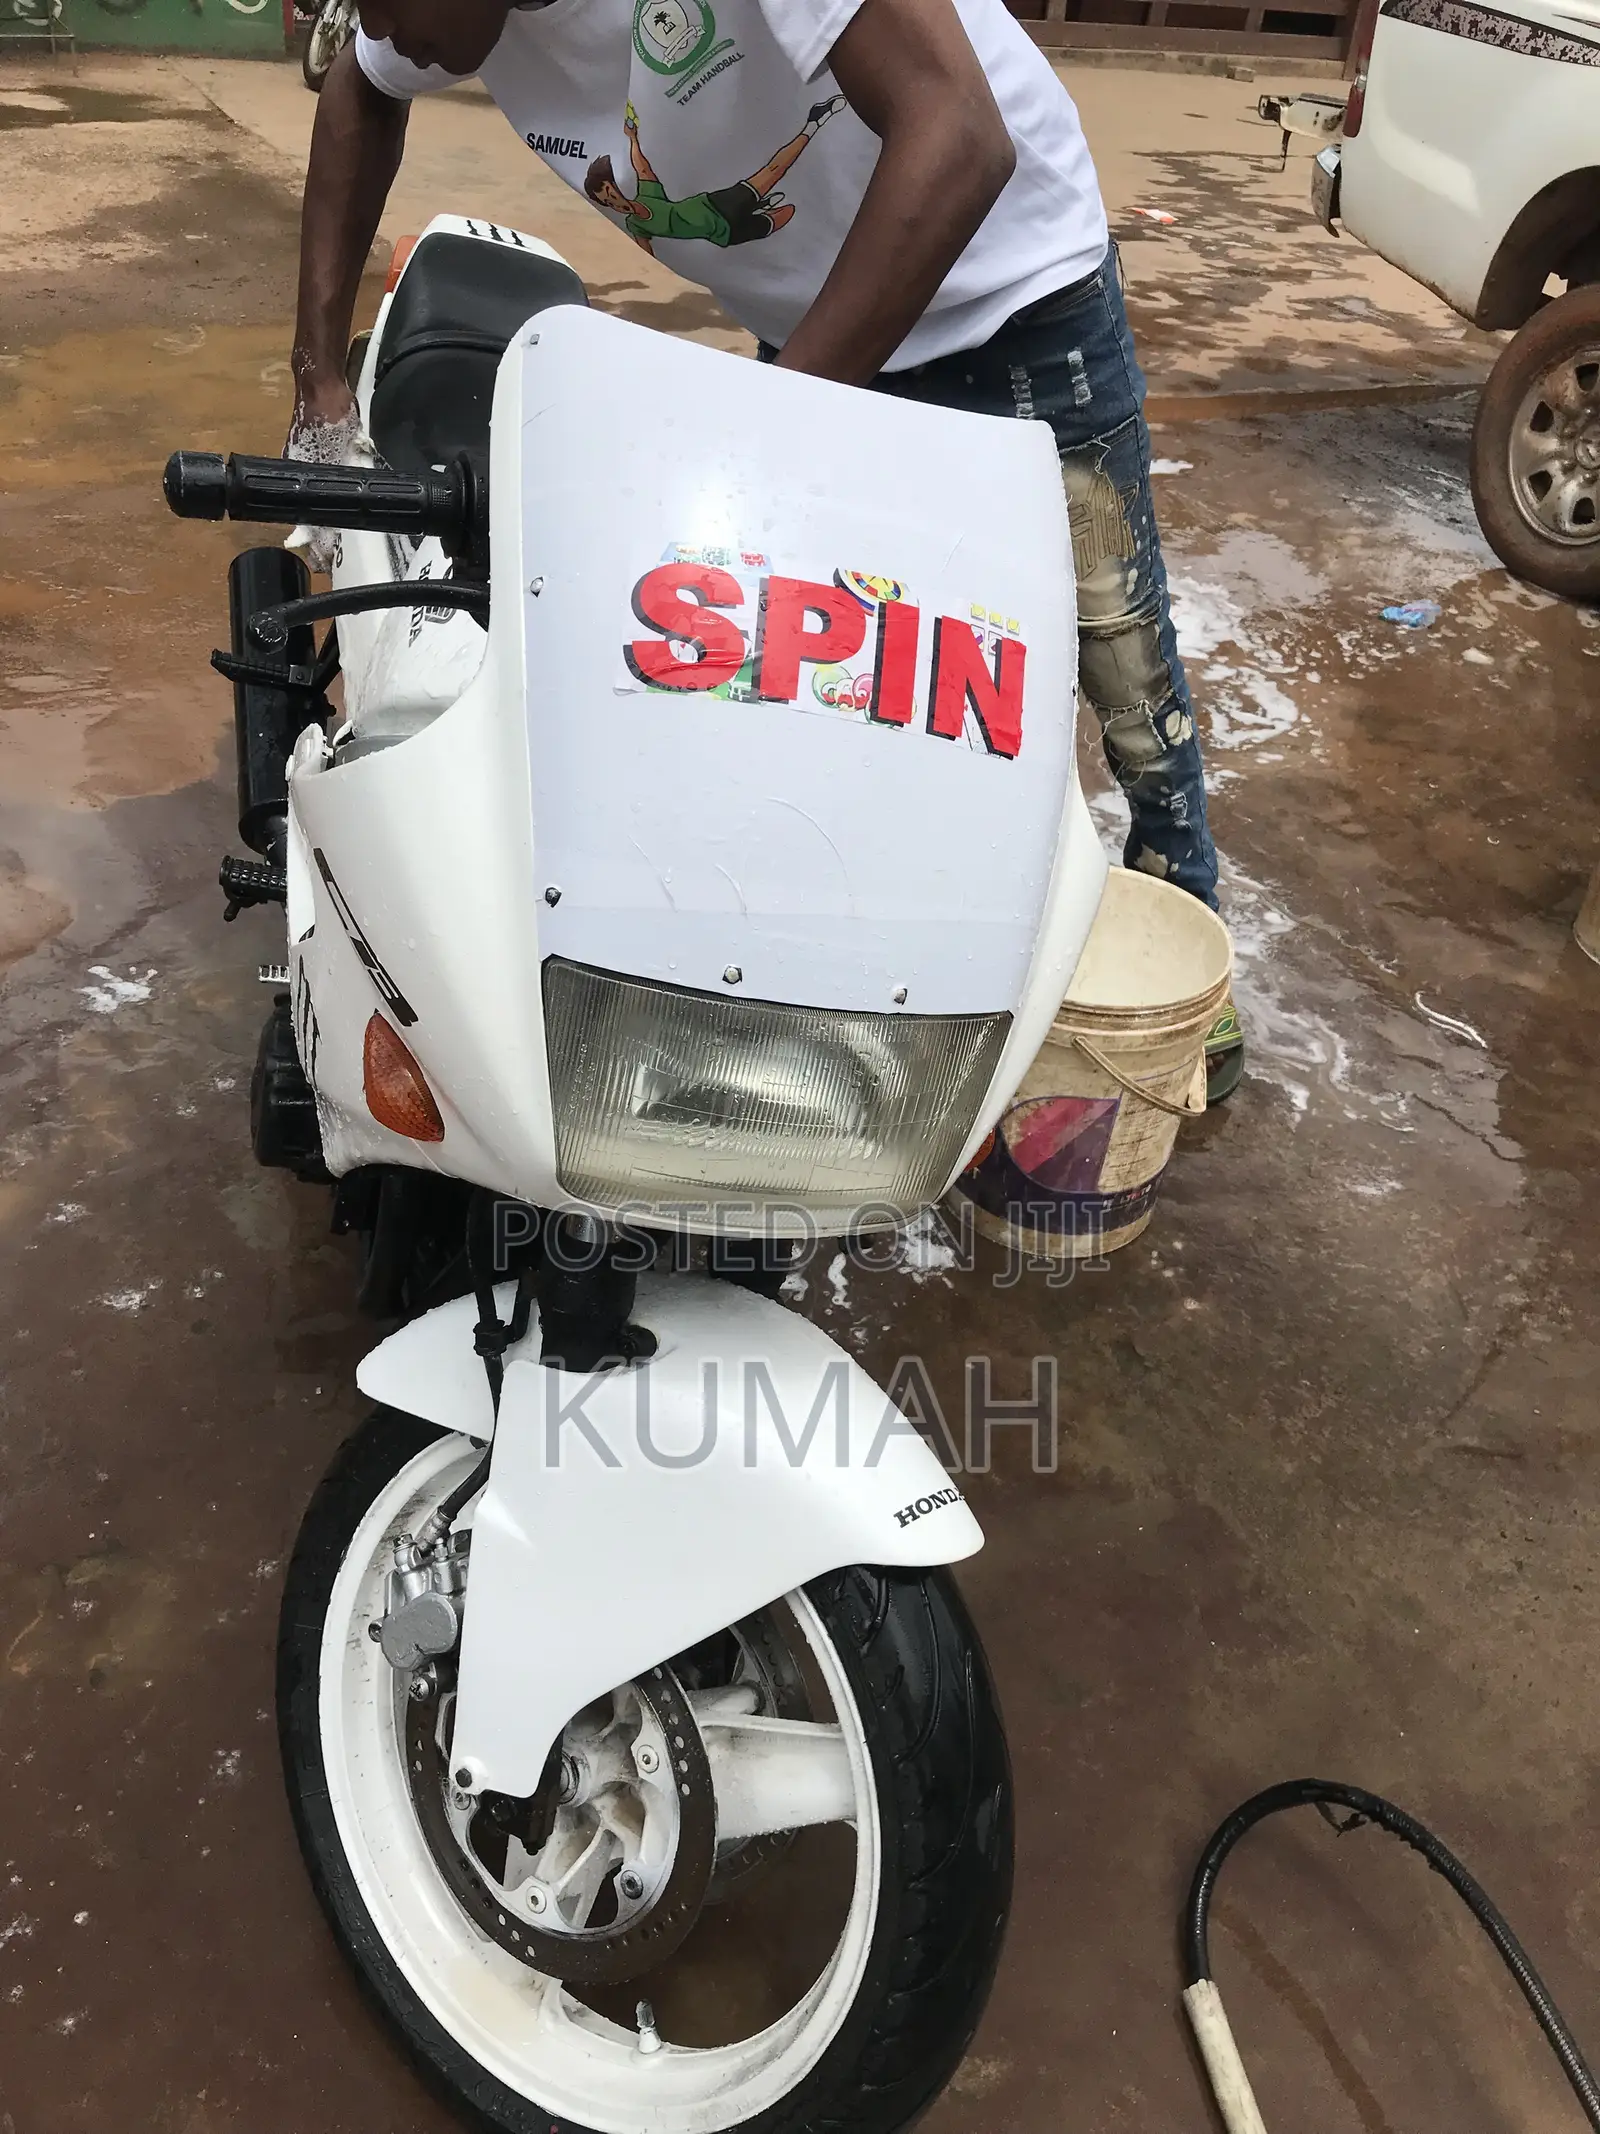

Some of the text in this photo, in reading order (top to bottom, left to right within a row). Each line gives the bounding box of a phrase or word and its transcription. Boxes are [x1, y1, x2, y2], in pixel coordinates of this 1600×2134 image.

[676, 82, 702, 106] TEAM
[700, 51, 745, 85] HANDBALL
[526, 132, 588, 159] SAMUEL
[622, 562, 1027, 761] SPIN
